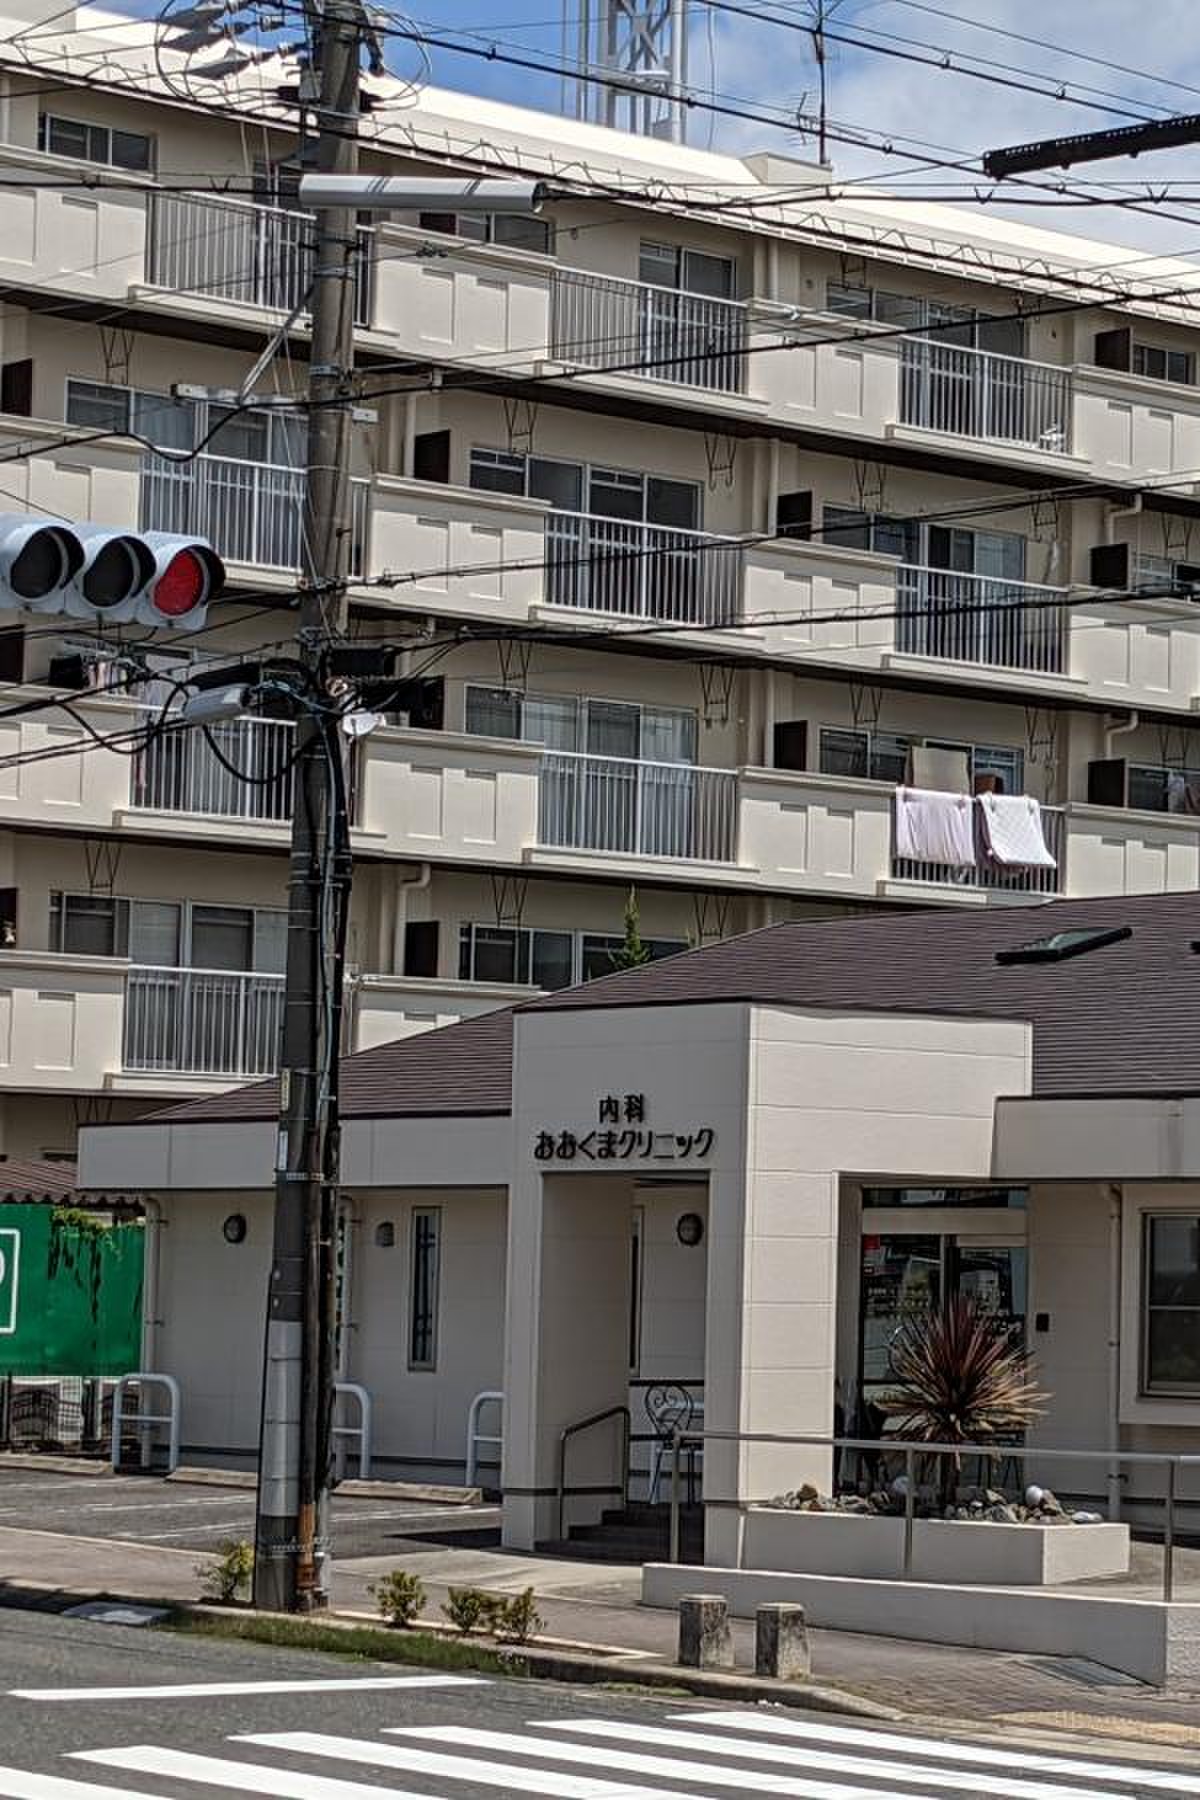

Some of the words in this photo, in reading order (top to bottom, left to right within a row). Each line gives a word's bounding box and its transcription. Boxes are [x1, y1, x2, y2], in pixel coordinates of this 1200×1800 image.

[599, 1093, 645, 1124] 内科
[533, 1128, 715, 1160] おおくまクリニック
